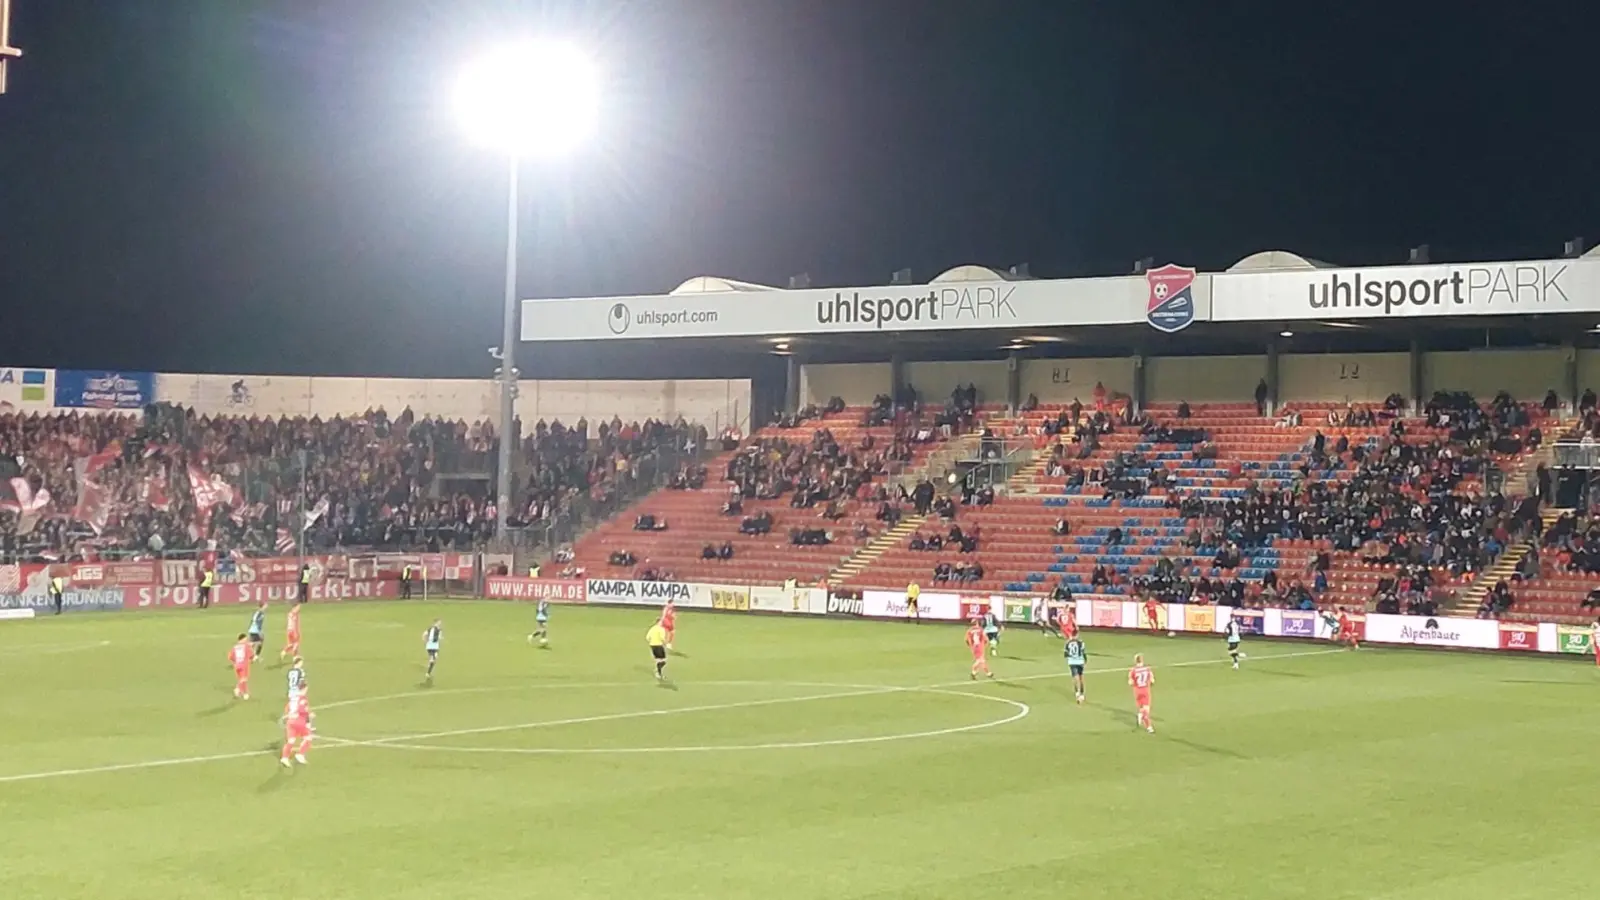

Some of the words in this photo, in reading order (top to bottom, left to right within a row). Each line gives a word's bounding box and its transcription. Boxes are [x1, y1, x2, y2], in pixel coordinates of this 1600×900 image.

[1309, 264, 1569, 315] uhlsportPARK
[636, 309, 718, 327] uhlsport.com
[817, 286, 1017, 330] uhlsportPARK
[488, 581, 584, 600] WWW.FHAM.DE
[588, 579, 637, 598] KAMPA
[641, 582, 691, 600] KAMPA
[828, 592, 864, 615] bwin
[1400, 625, 1461, 642] Alpenbauer
